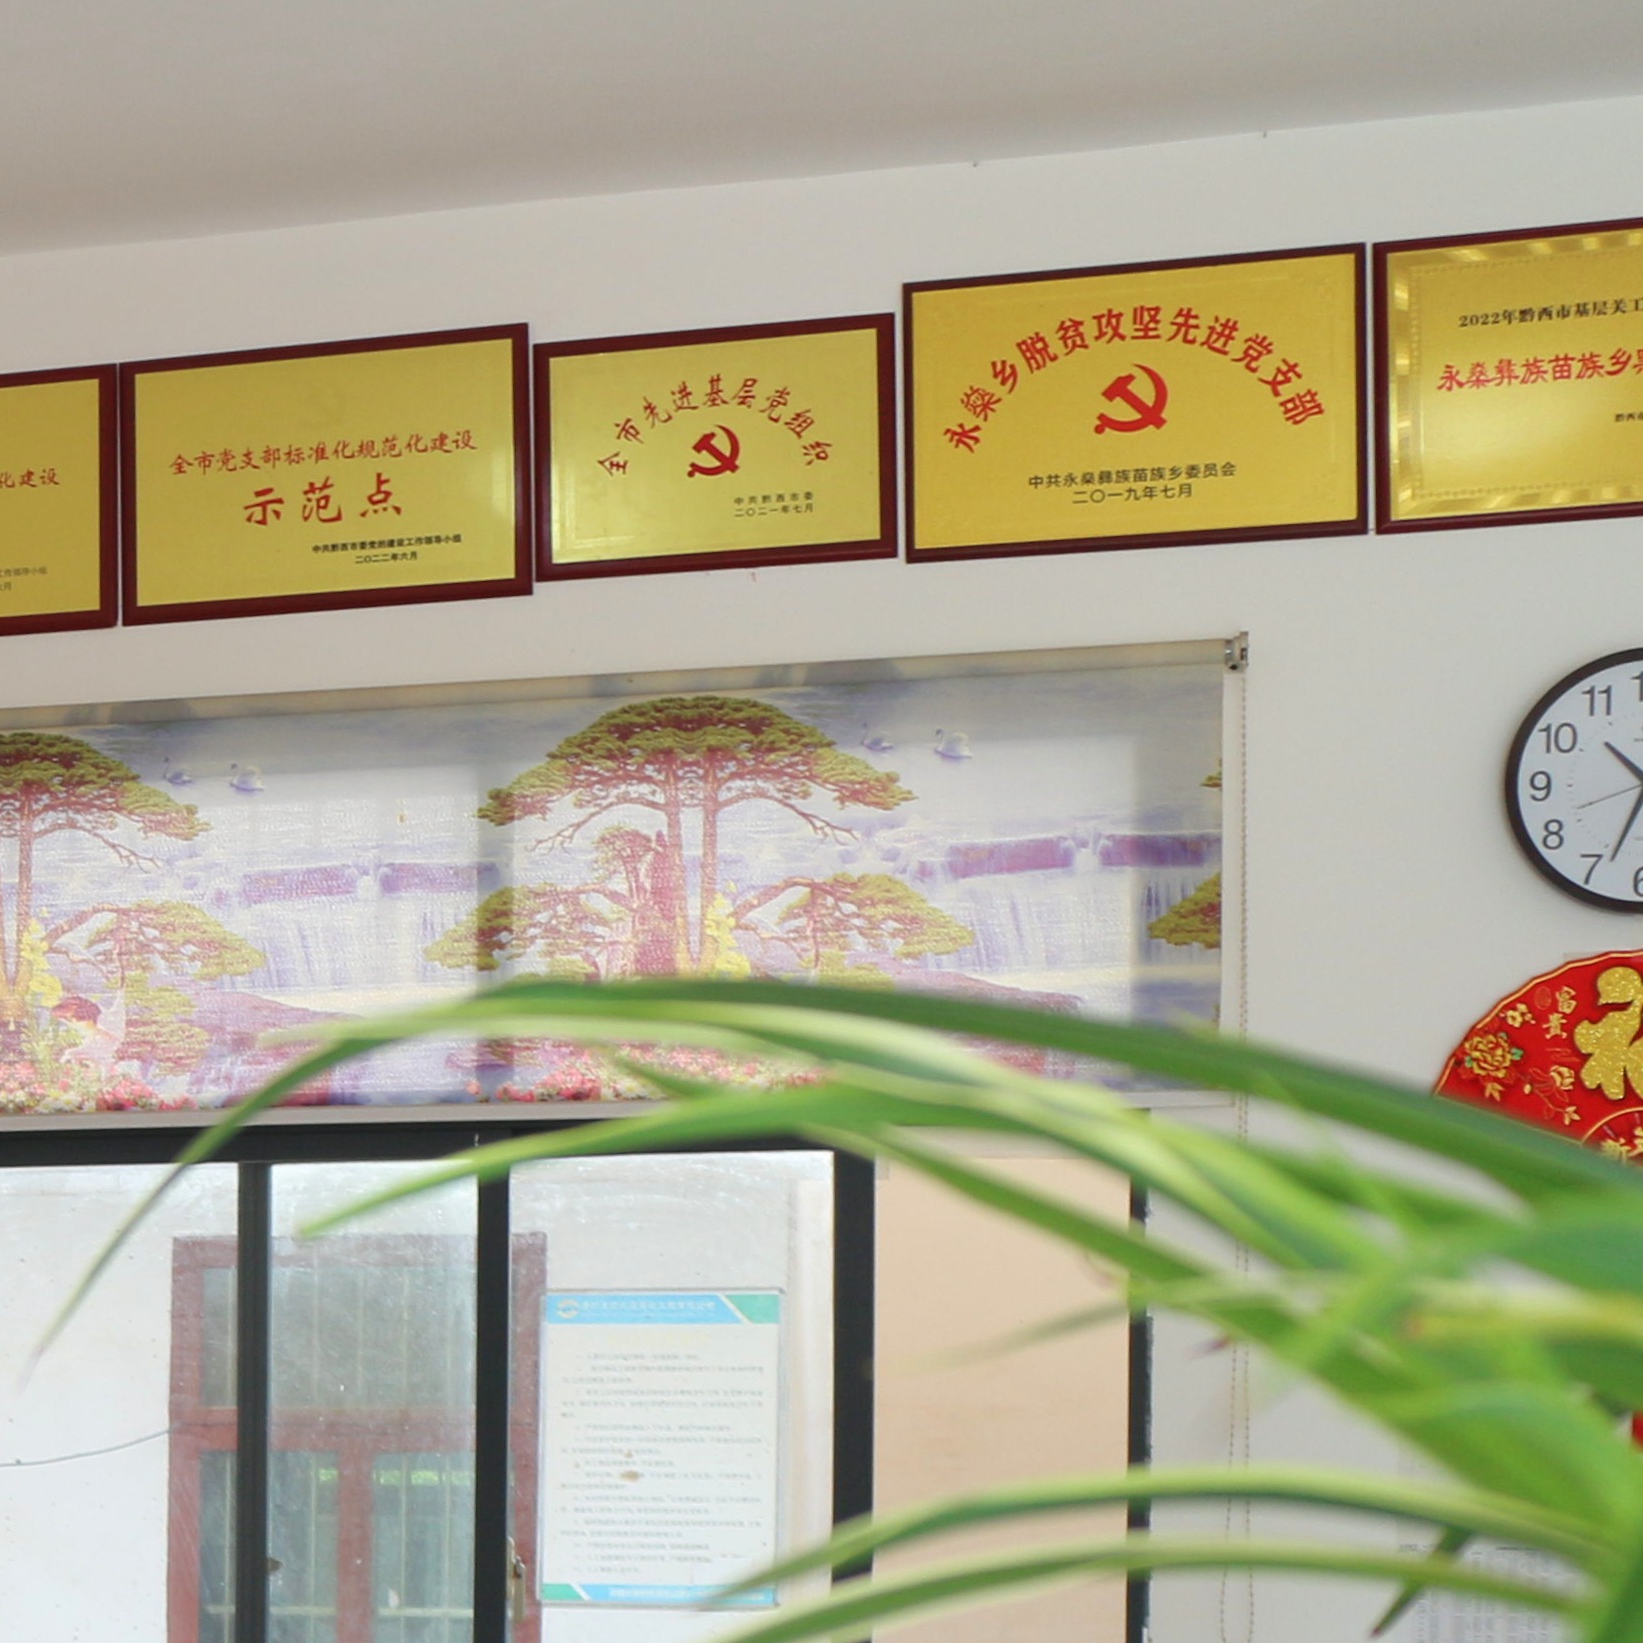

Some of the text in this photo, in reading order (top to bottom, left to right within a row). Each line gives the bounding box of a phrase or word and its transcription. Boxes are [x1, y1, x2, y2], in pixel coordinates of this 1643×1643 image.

[943, 305, 1325, 453] 永燊乡脱贫攻坚先进党支部
[597, 373, 833, 477] 全市先进基层党组织
[169, 430, 477, 476] 全市党支部标准化规范化建设
[1028, 462, 1237, 489] 中共永燊彝族苗族乡委员会
[243, 472, 402, 526] 示范点
[1582, 685, 1613, 716] 11
[1538, 722, 1578, 754] 10
[1529, 771, 1552, 802] 9
[1542, 818, 1564, 850] 8
[1580, 854, 1603, 885] 7
